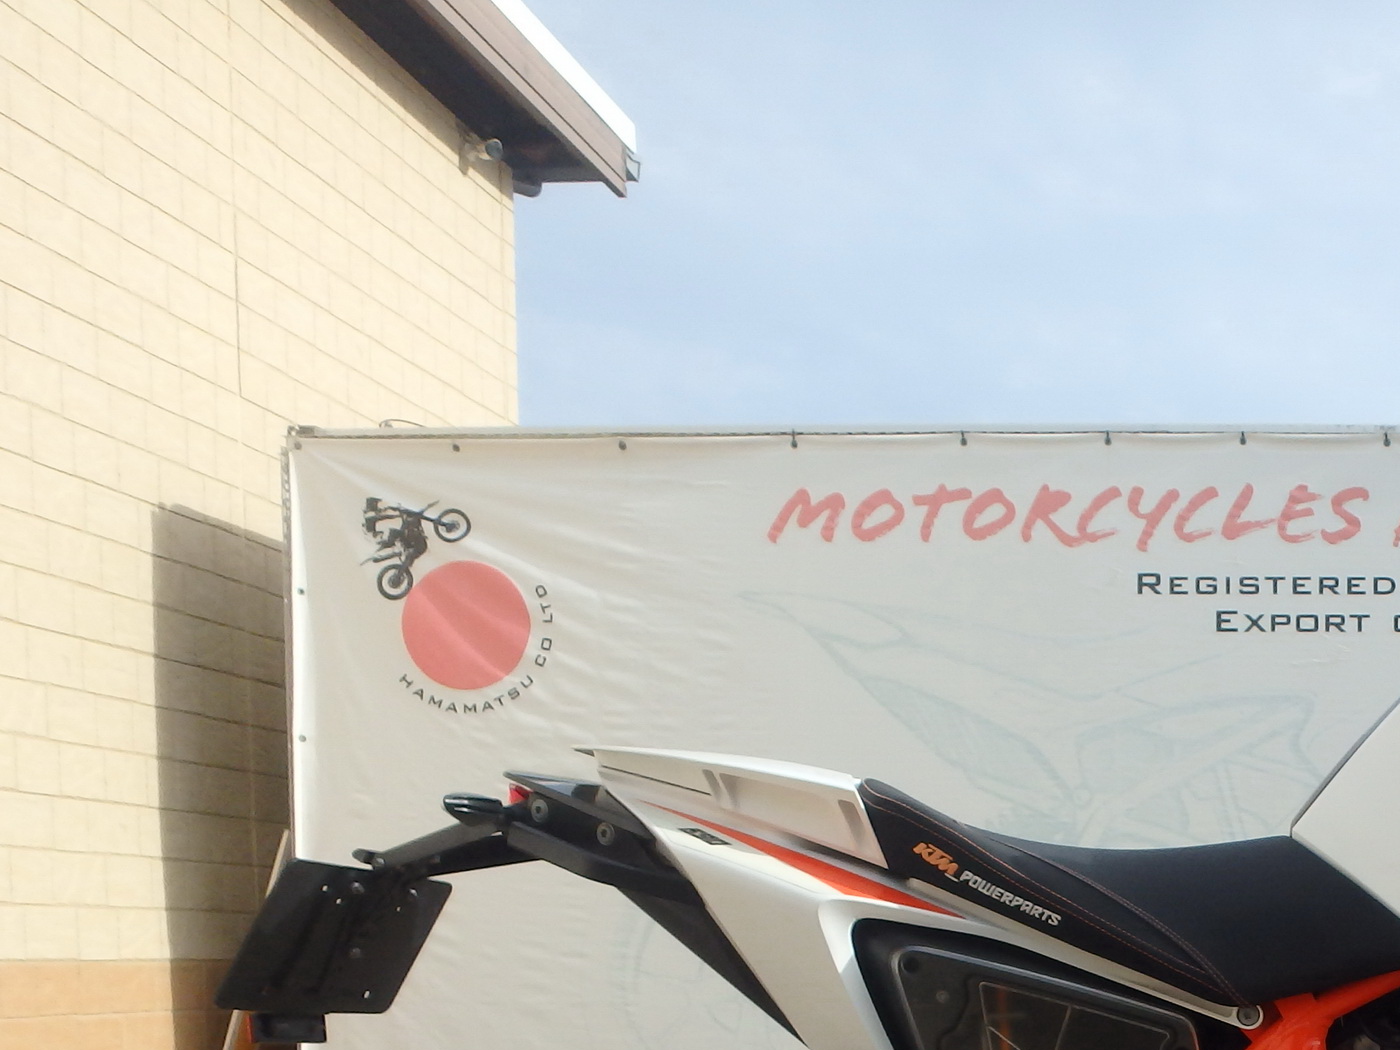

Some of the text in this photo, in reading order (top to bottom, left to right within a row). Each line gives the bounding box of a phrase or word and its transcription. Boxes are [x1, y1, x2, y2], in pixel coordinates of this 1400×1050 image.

[767, 482, 1371, 552] MOTORCYCLES
[1136, 572, 1397, 596] REGISTERED
[1215, 609, 1371, 633] EXPORT
[399, 584, 554, 714] HAMAMATSU CO LTD
